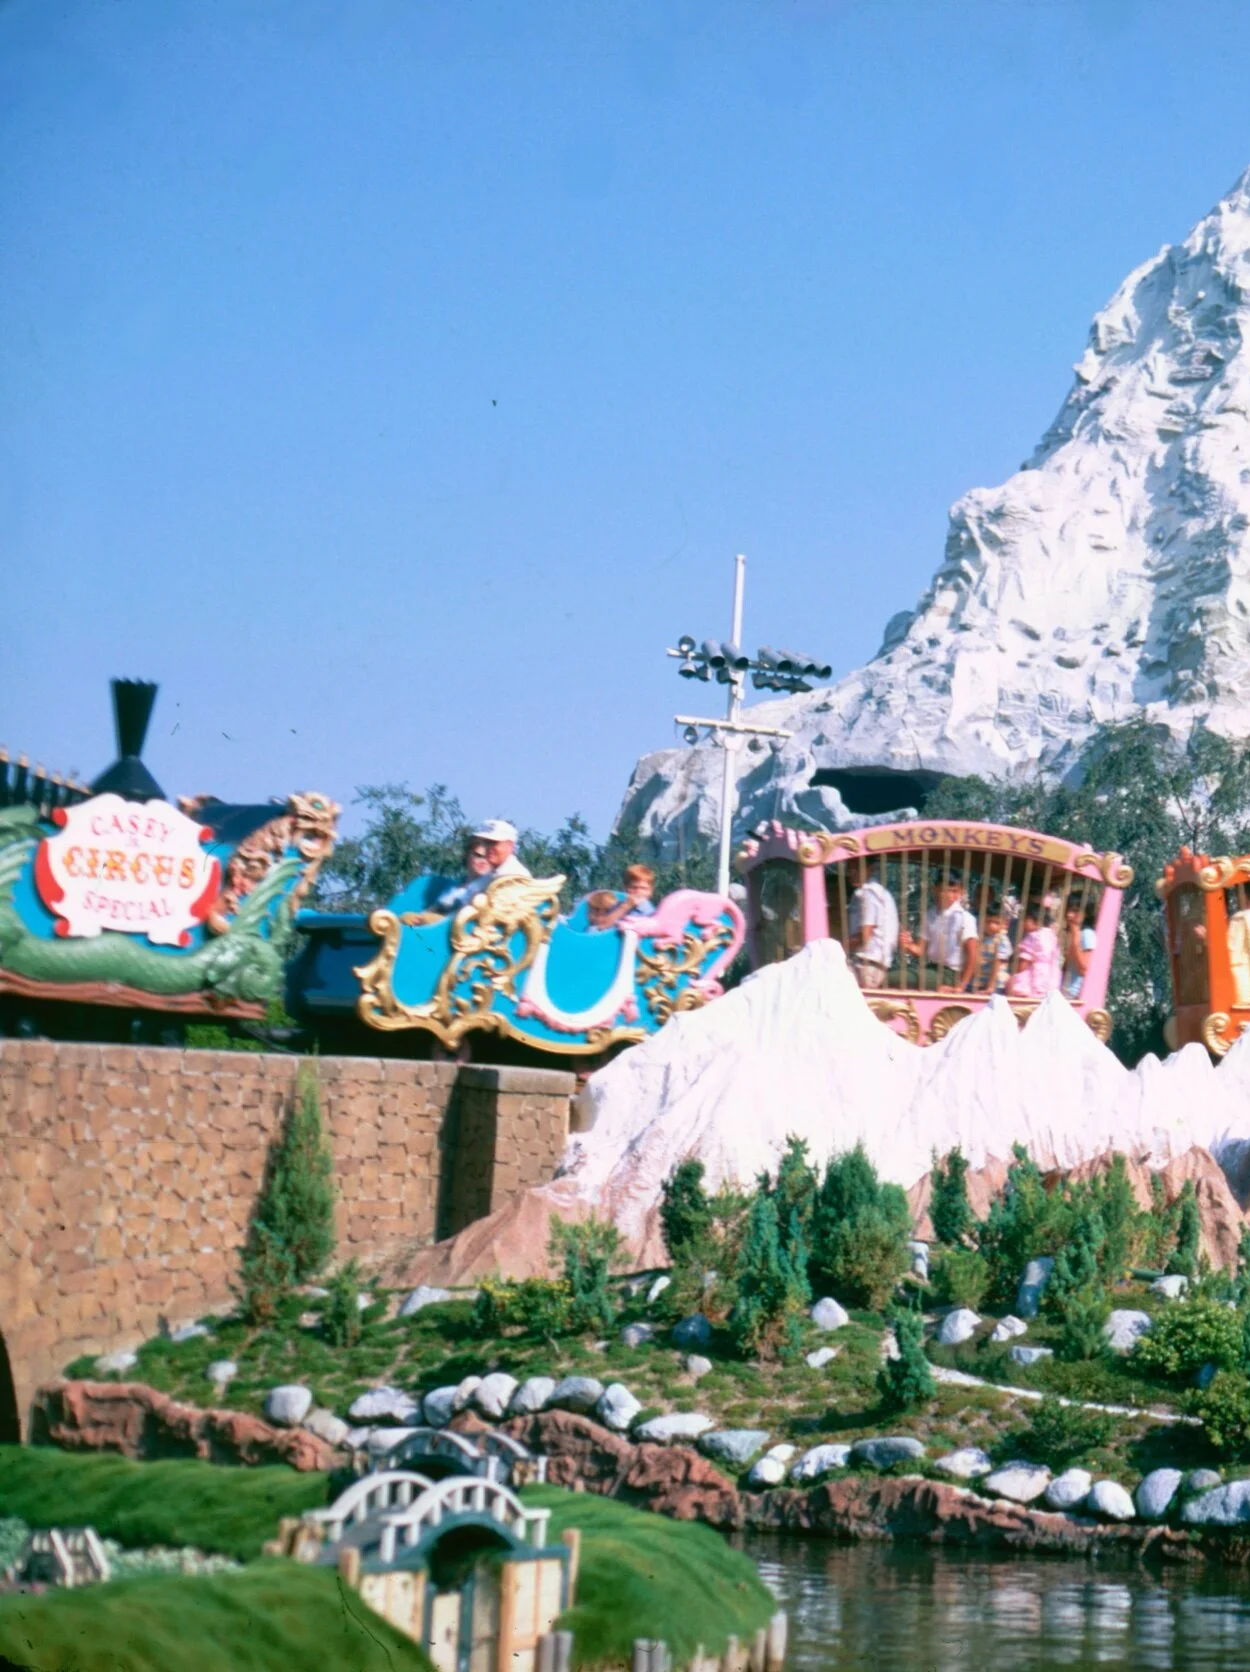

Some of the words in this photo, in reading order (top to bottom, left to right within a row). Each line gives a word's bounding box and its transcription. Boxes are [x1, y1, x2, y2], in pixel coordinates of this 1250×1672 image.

[91, 814, 174, 842] CASEY
[893, 827, 1047, 854] MONKEYS
[63, 846, 195, 889] CIRCUS
[83, 890, 172, 921] SPECIAL
